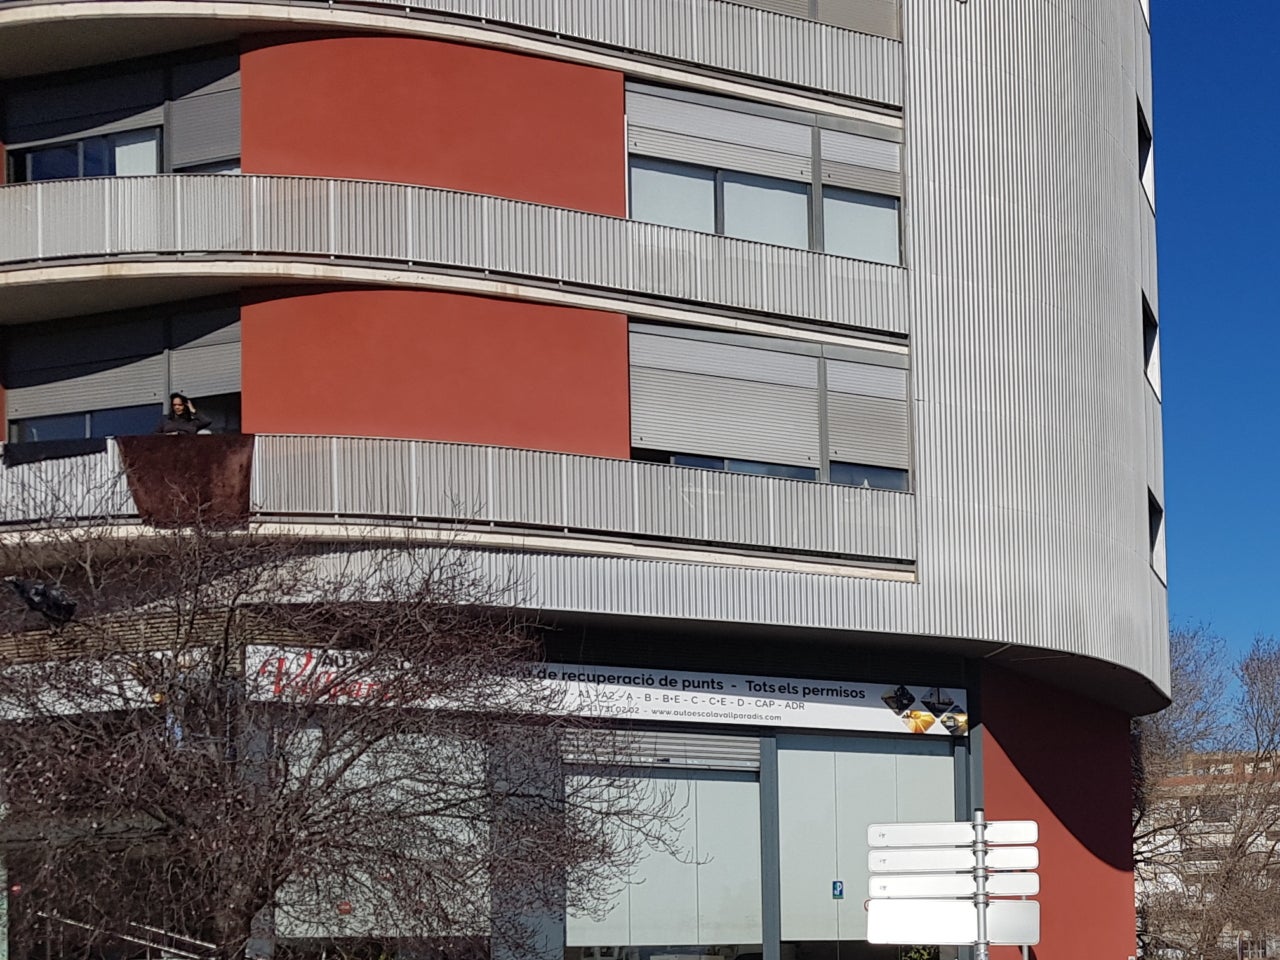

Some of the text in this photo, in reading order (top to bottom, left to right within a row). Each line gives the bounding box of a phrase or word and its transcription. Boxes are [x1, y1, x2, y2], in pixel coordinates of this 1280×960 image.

[537, 668, 557, 680] de
[562, 670, 655, 686] recuperació
[658, 675, 678, 687] de
[682, 677, 724, 691] punts
[745, 680, 776, 693] Tots
[778, 682, 799, 695] els
[802, 685, 866, 699] permisos
[601, 691, 615, 700] A2
[626, 693, 633, 701] A
[645, 693, 652, 702] B
[691, 696, 699, 705] C
[737, 698, 745, 707] D
[755, 700, 776, 708] CAP
[784, 702, 805, 711] ADR
[651, 708, 782, 721] www.autoescolavallparadis.com
